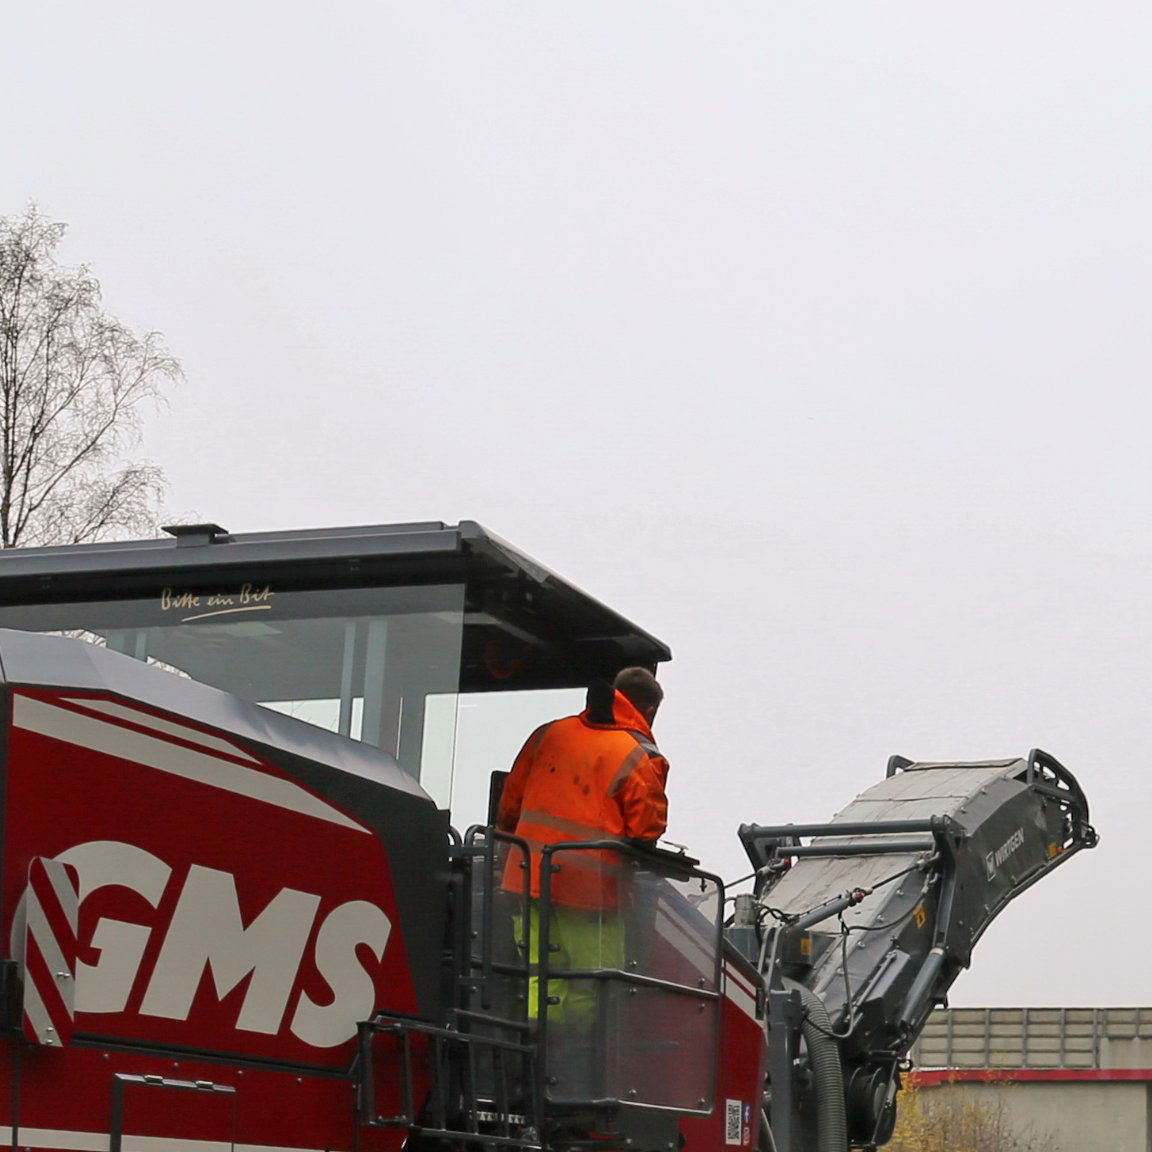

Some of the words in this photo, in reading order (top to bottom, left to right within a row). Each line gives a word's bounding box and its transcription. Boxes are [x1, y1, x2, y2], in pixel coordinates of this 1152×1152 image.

[161, 587, 200, 610] Bitte
[207, 594, 234, 606] ein
[240, 583, 274, 604] Bit
[10, 840, 392, 1048] GMS
